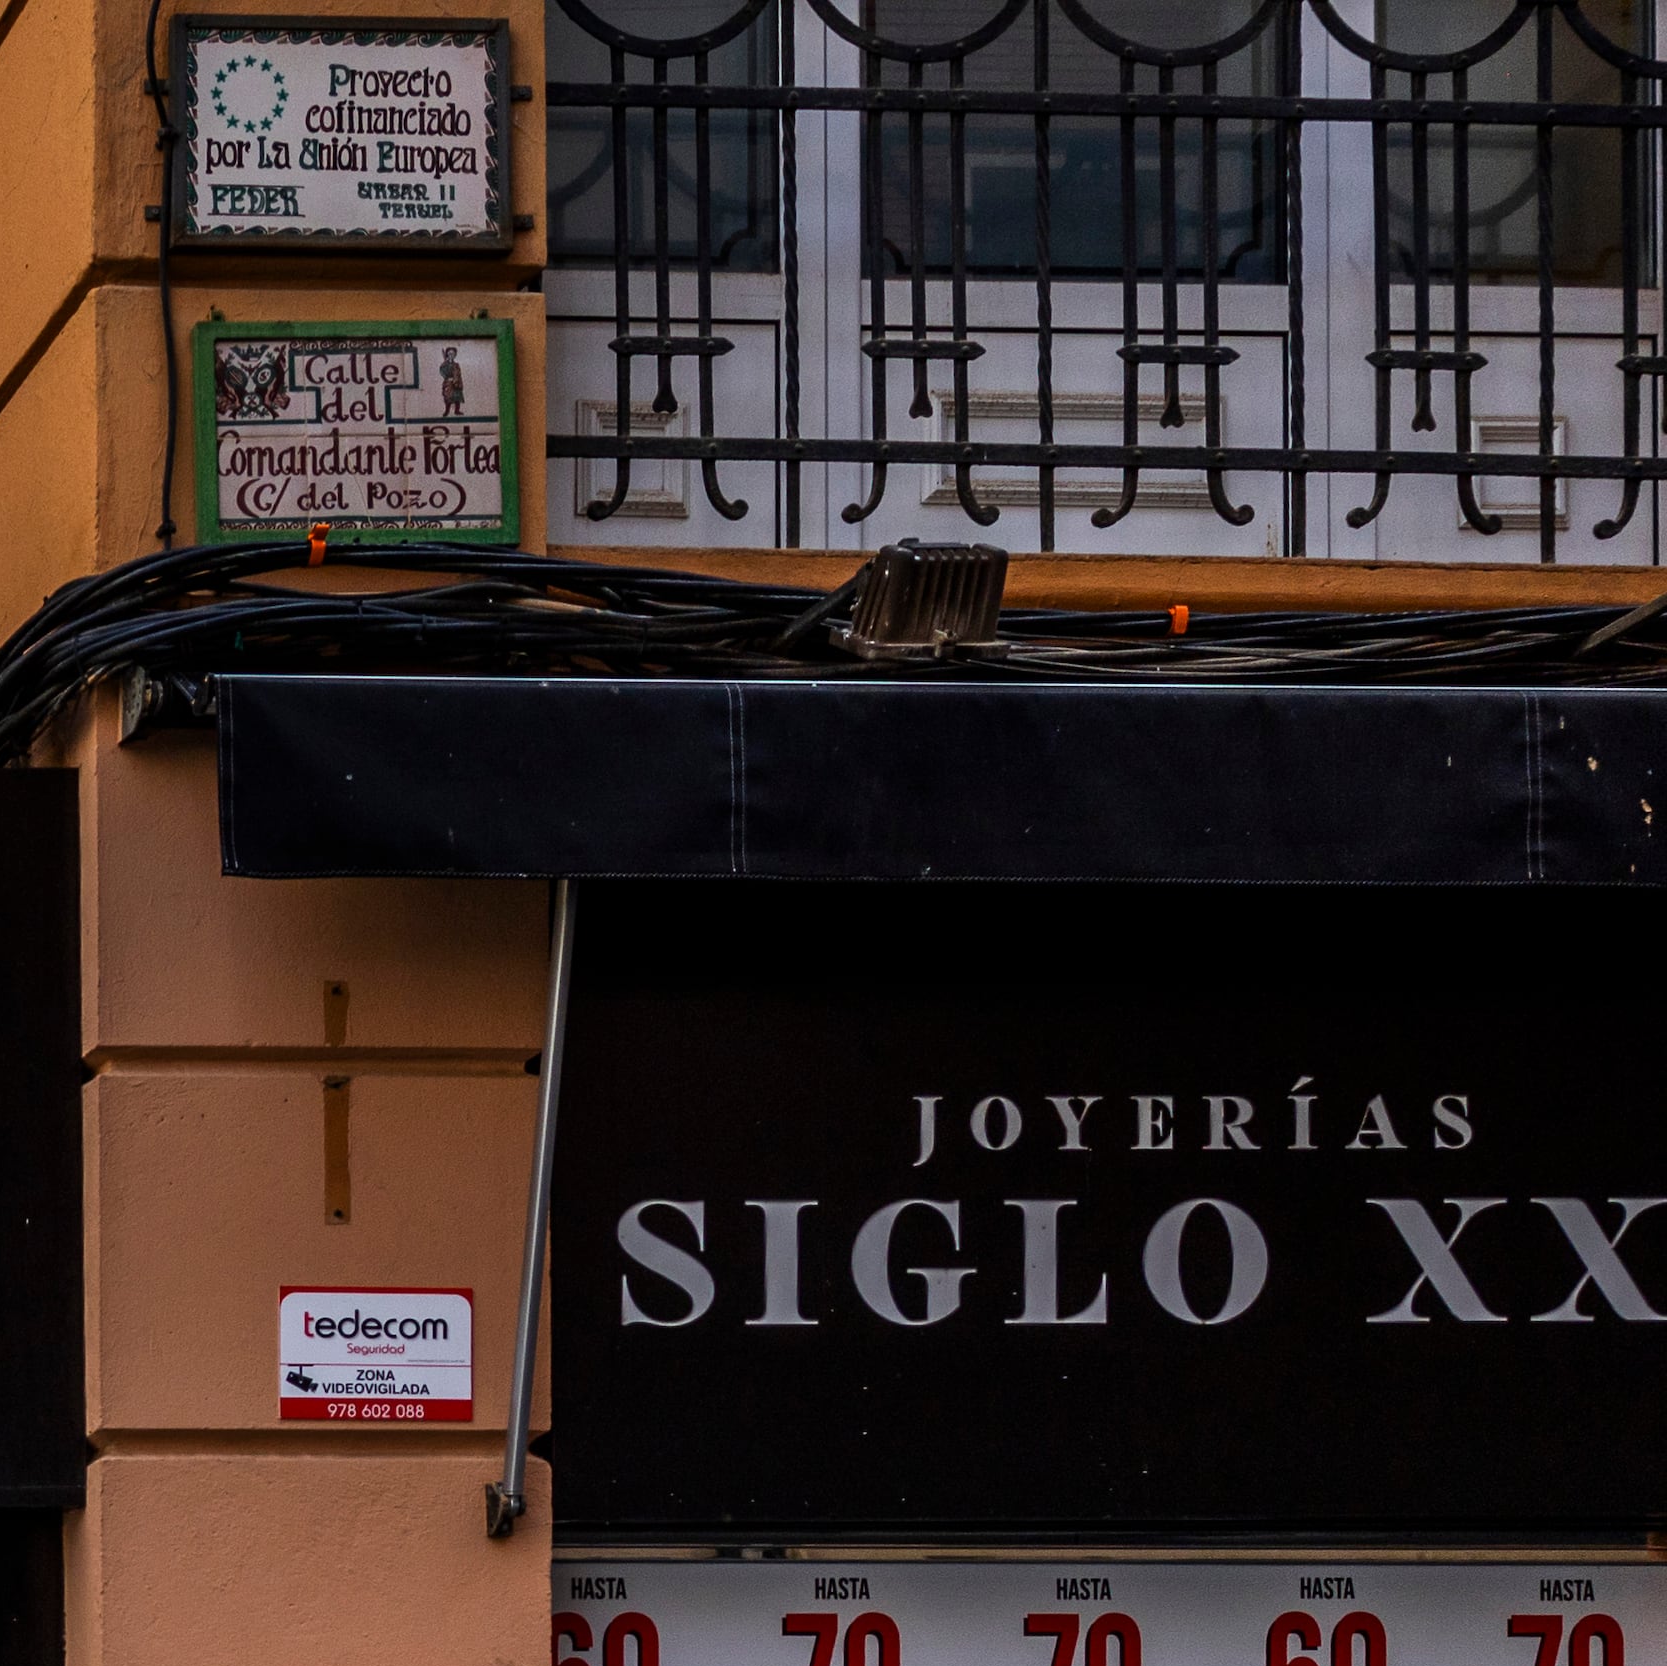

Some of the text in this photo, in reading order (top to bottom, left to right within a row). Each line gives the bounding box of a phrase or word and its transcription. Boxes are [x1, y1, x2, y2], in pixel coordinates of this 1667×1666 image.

[328, 63, 452, 98] Proyecto
[304, 100, 472, 137] cofinanciado
[205, 135, 479, 179] por La Unión Europea
[210, 184, 300, 216] FEDER
[357, 181, 430, 201] URBAN
[378, 202, 454, 220] TERUEL
[304, 352, 400, 385] Calle
[320, 387, 385, 423] del
[217, 427, 417, 478] Comandante
[296, 482, 350, 511] del
[367, 478, 467, 517] Pozo)
[913, 1076, 1474, 1167] JOYERÍAS
[619, 1197, 1269, 1328] SIGLO
[303, 1309, 449, 1339] tedecom
[346, 1343, 406, 1355] Seguridad
[355, 1369, 396, 1381] ZONA
[322, 1382, 430, 1395] VIDEOVIGILADA
[327, 1403, 425, 1418] 978 602 088
[571, 1577, 627, 1600] HASTA
[814, 1577, 870, 1600] HASTA
[1056, 1577, 1112, 1600] HASTA
[1300, 1577, 1355, 1600] HASTA
[1539, 1579, 1595, 1602] HASTA
